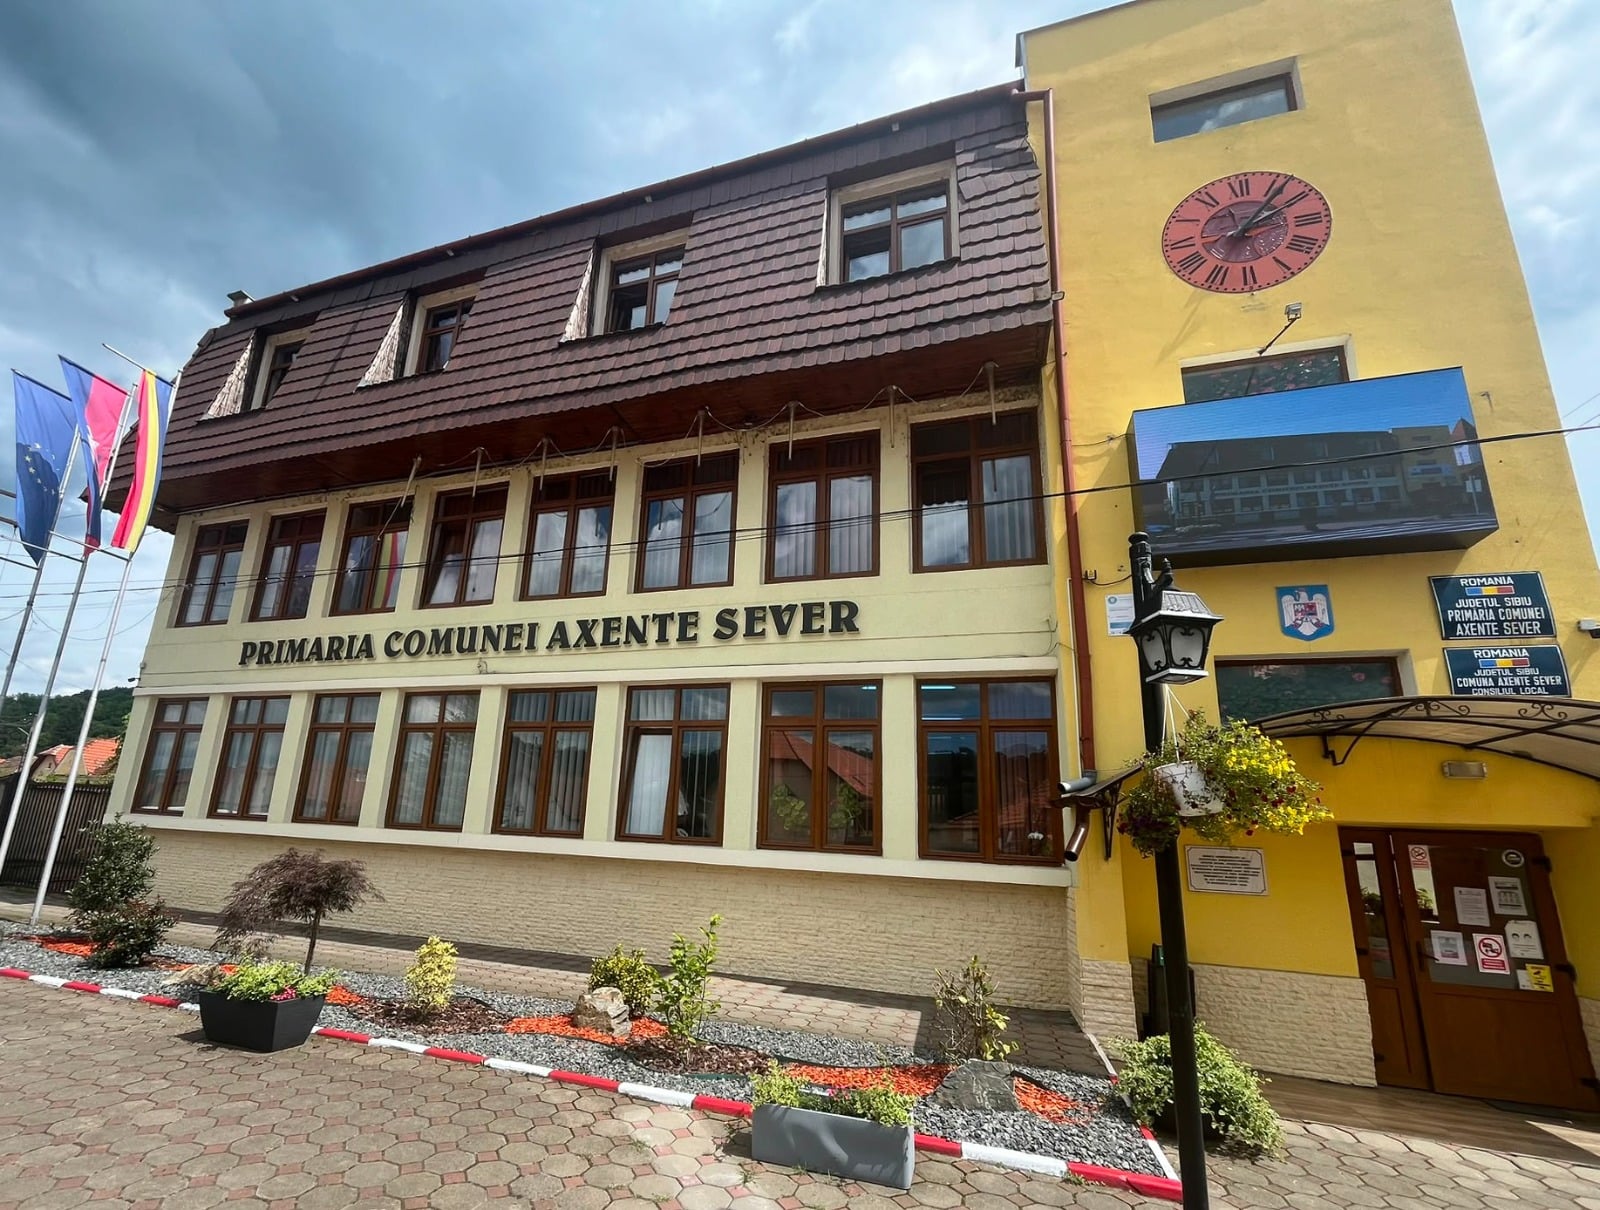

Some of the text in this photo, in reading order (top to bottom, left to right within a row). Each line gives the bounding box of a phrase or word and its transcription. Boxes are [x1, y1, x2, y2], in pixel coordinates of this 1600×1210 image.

[1459, 576, 1514, 587] ROMANIA
[1504, 596, 1533, 607] SIBIU
[1498, 607, 1546, 621] COMUNEI
[238, 600, 860, 666] PRIMARIA COMUNEI AXENTE SEVER
[1456, 621, 1542, 637] AXENTE SEVER
[1473, 648, 1530, 658] ROMANIA
[1516, 667, 1540, 675] SIBIU
[1456, 675, 1562, 688] COMUNA AXENTE SEVER
[1471, 686, 1549, 696] CONSILIUL LOCAL
